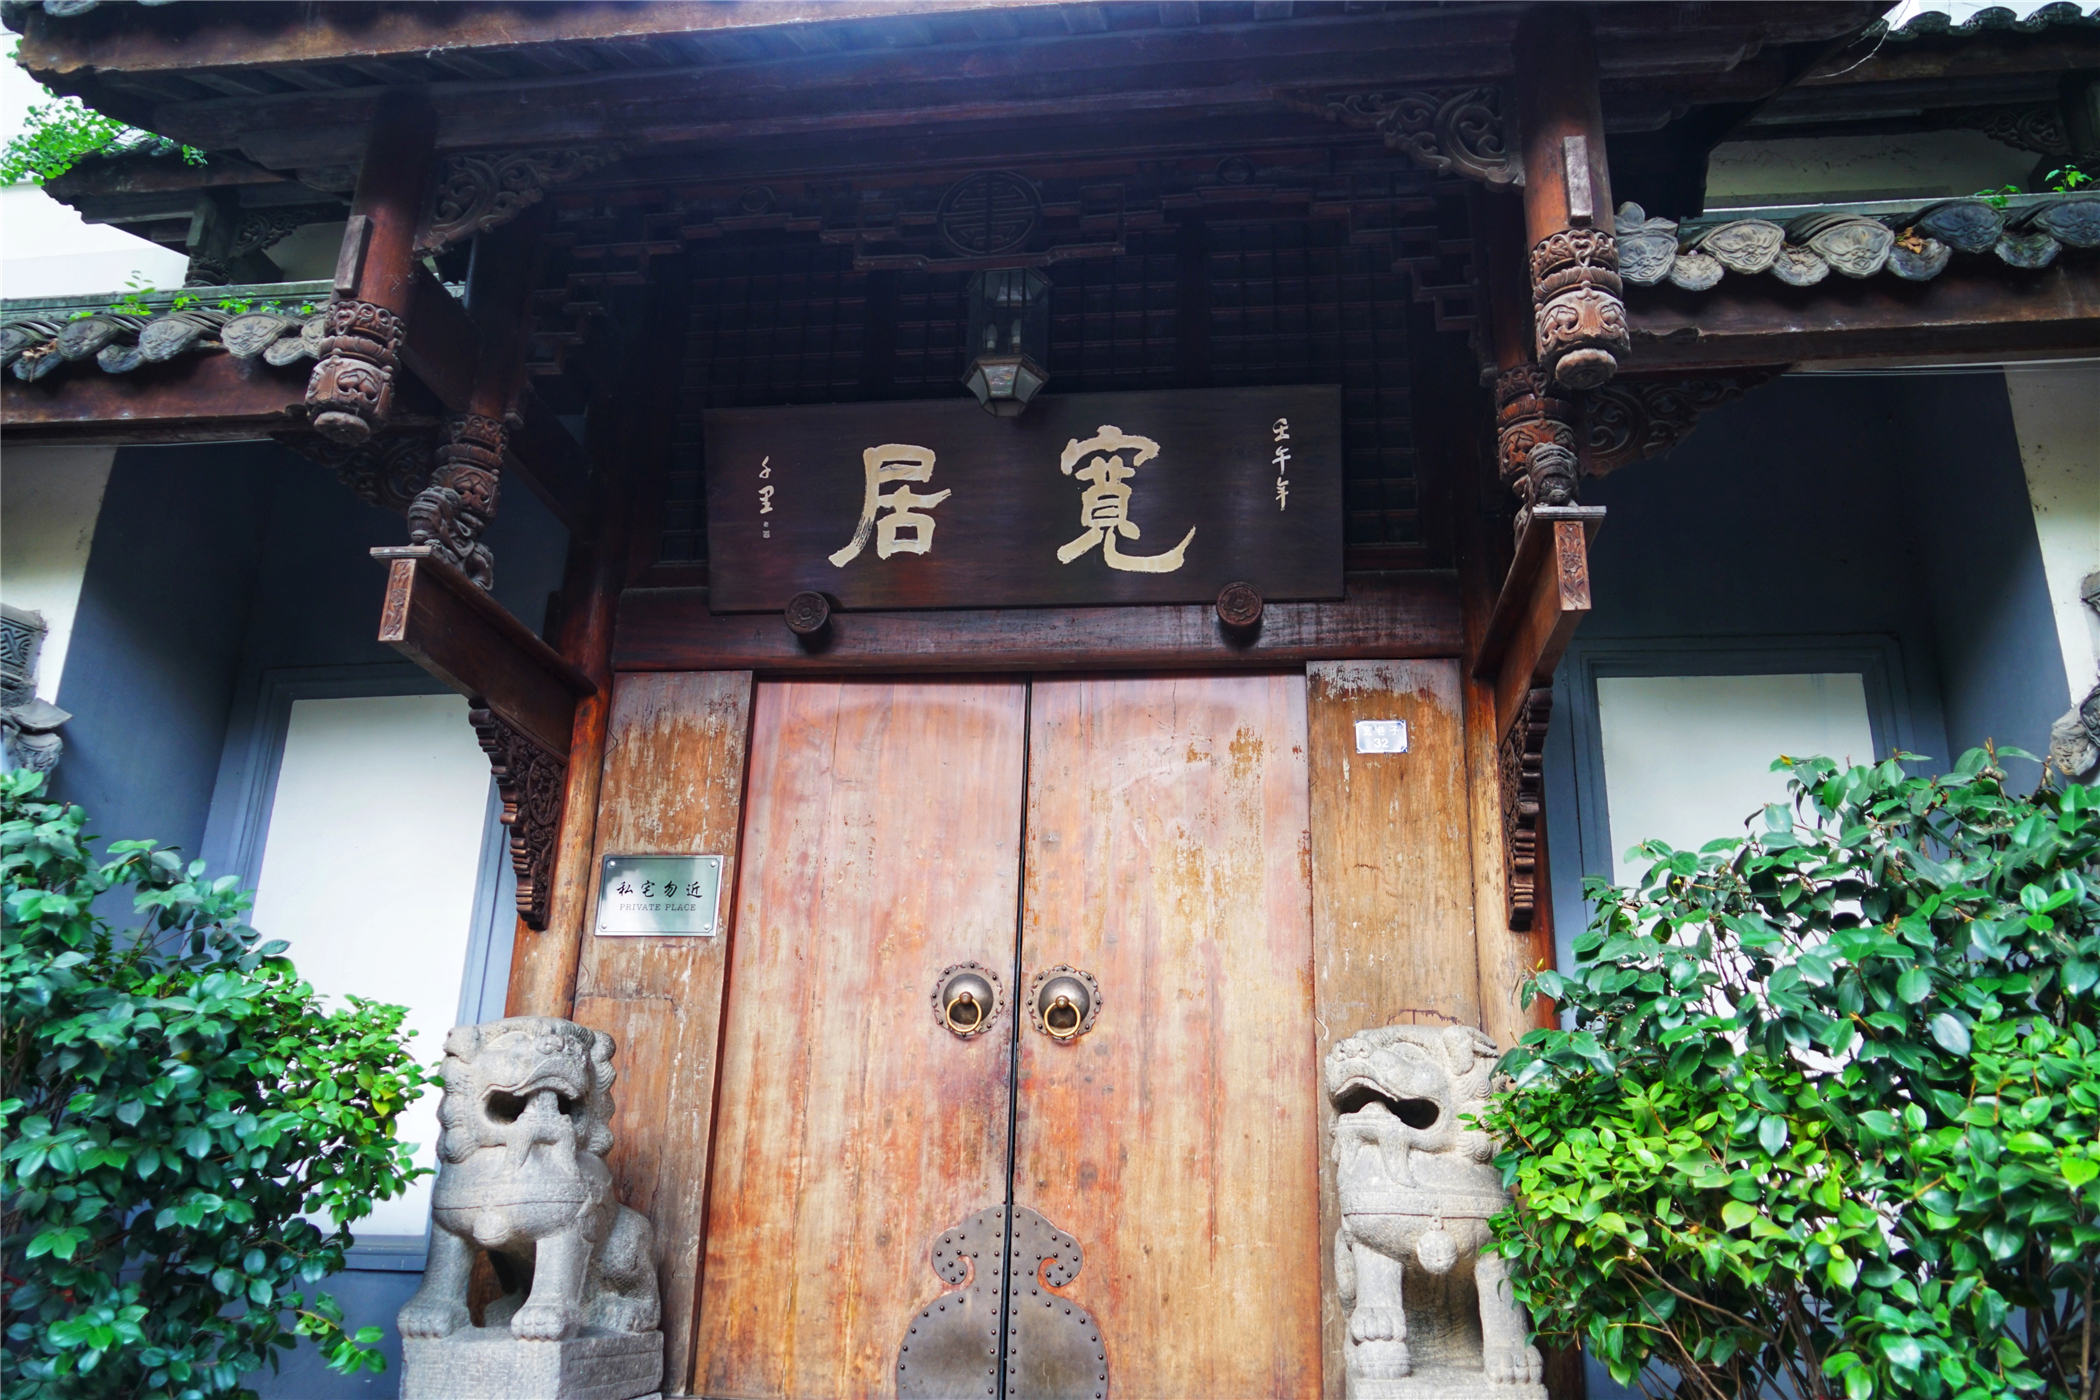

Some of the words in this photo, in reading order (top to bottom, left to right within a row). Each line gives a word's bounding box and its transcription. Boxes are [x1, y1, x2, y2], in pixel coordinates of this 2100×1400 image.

[1362, 725, 1400, 736] 宽巷子
[1373, 737, 1389, 748] 32
[616, 880, 702, 898] 私宅勿近
[619, 903, 661, 911] PRIVATE
[665, 903, 696, 911] PLACE
